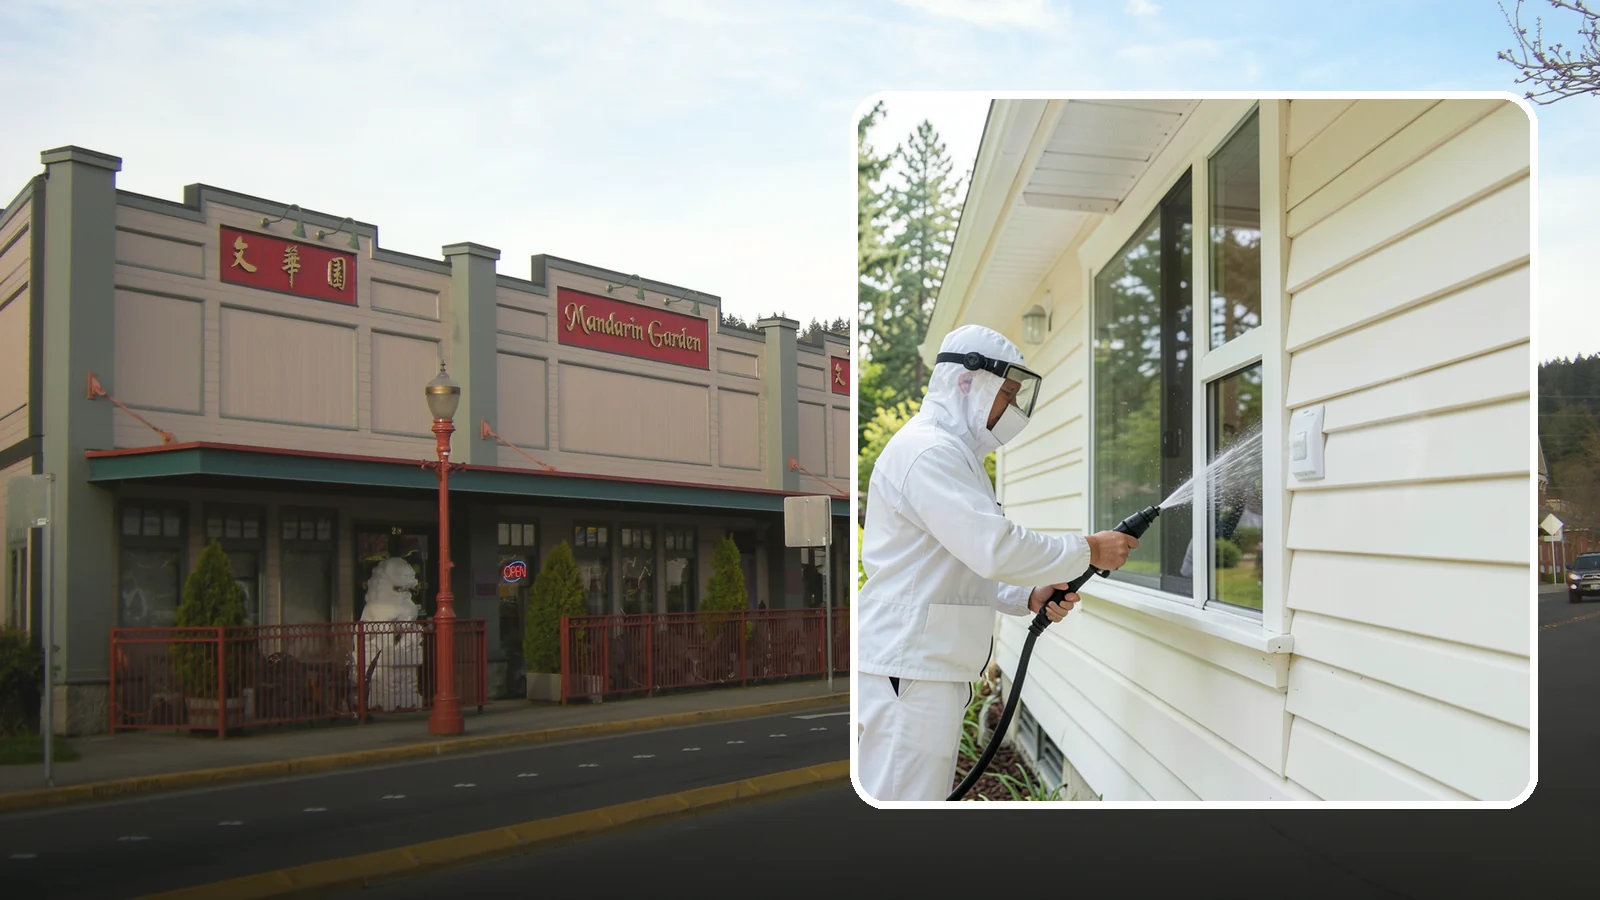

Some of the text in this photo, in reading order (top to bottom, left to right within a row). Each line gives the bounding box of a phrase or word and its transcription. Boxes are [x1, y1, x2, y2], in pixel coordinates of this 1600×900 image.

[231, 235, 346, 291] 文華園
[564, 302, 702, 352] Mandarin Garden
[503, 565, 526, 578] OPEN
